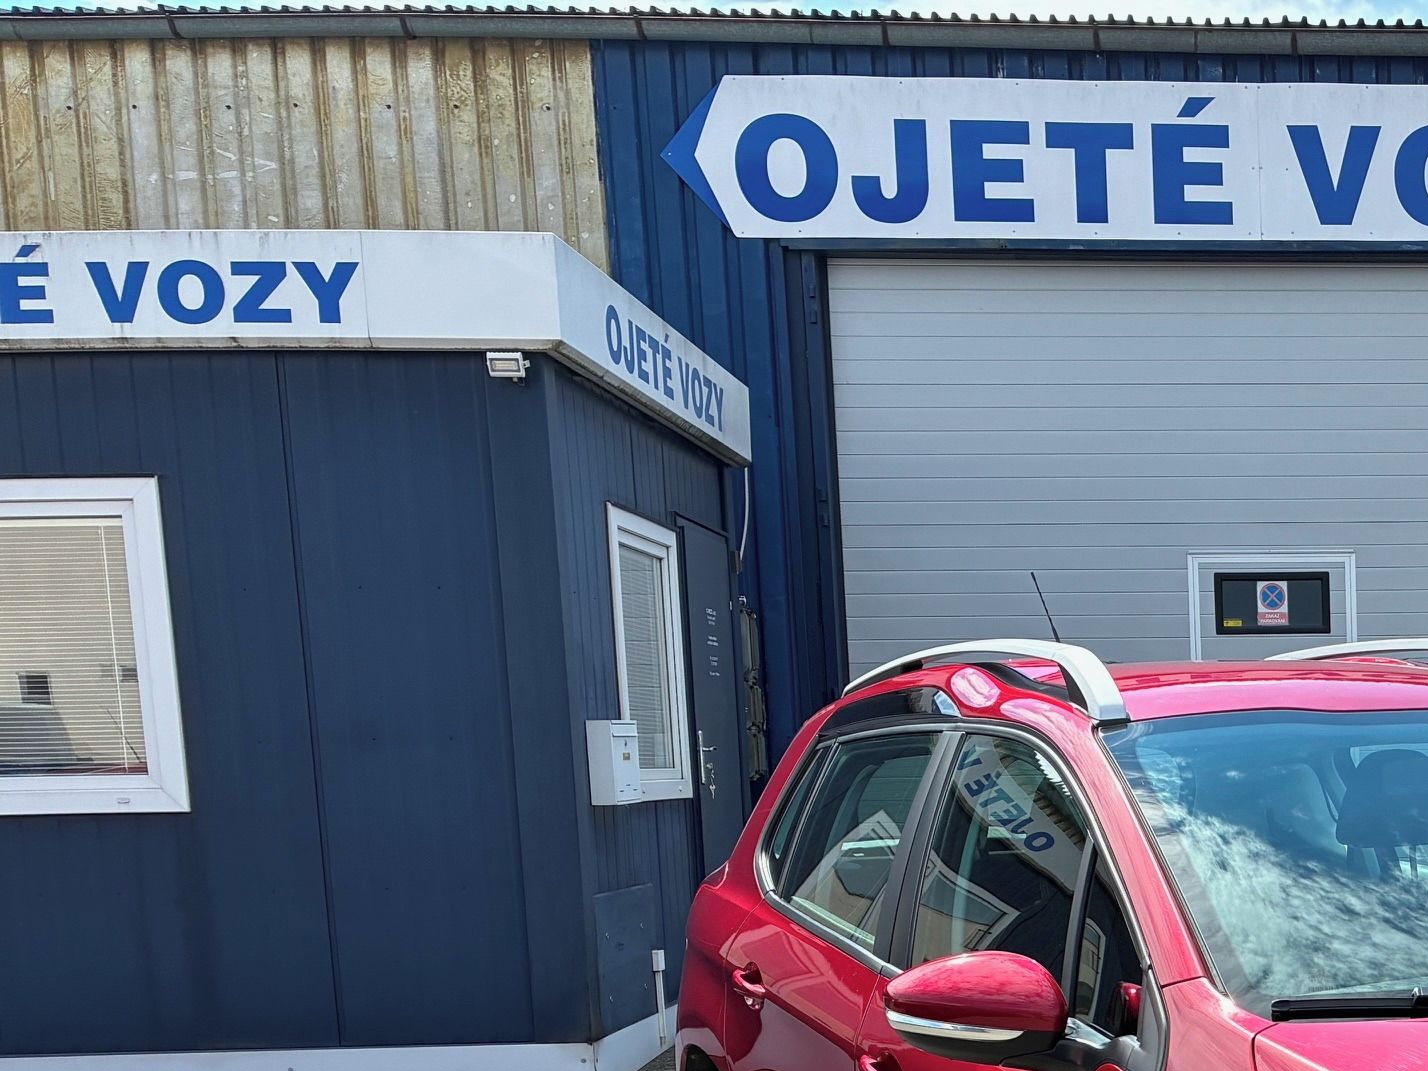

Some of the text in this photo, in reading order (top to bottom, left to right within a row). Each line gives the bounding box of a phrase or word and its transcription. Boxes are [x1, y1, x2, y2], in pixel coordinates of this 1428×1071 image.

[733, 97, 1233, 225] OJETÉ
[84, 259, 360, 325] VOZY
[605, 304, 724, 433] OJETÉ VOZY
